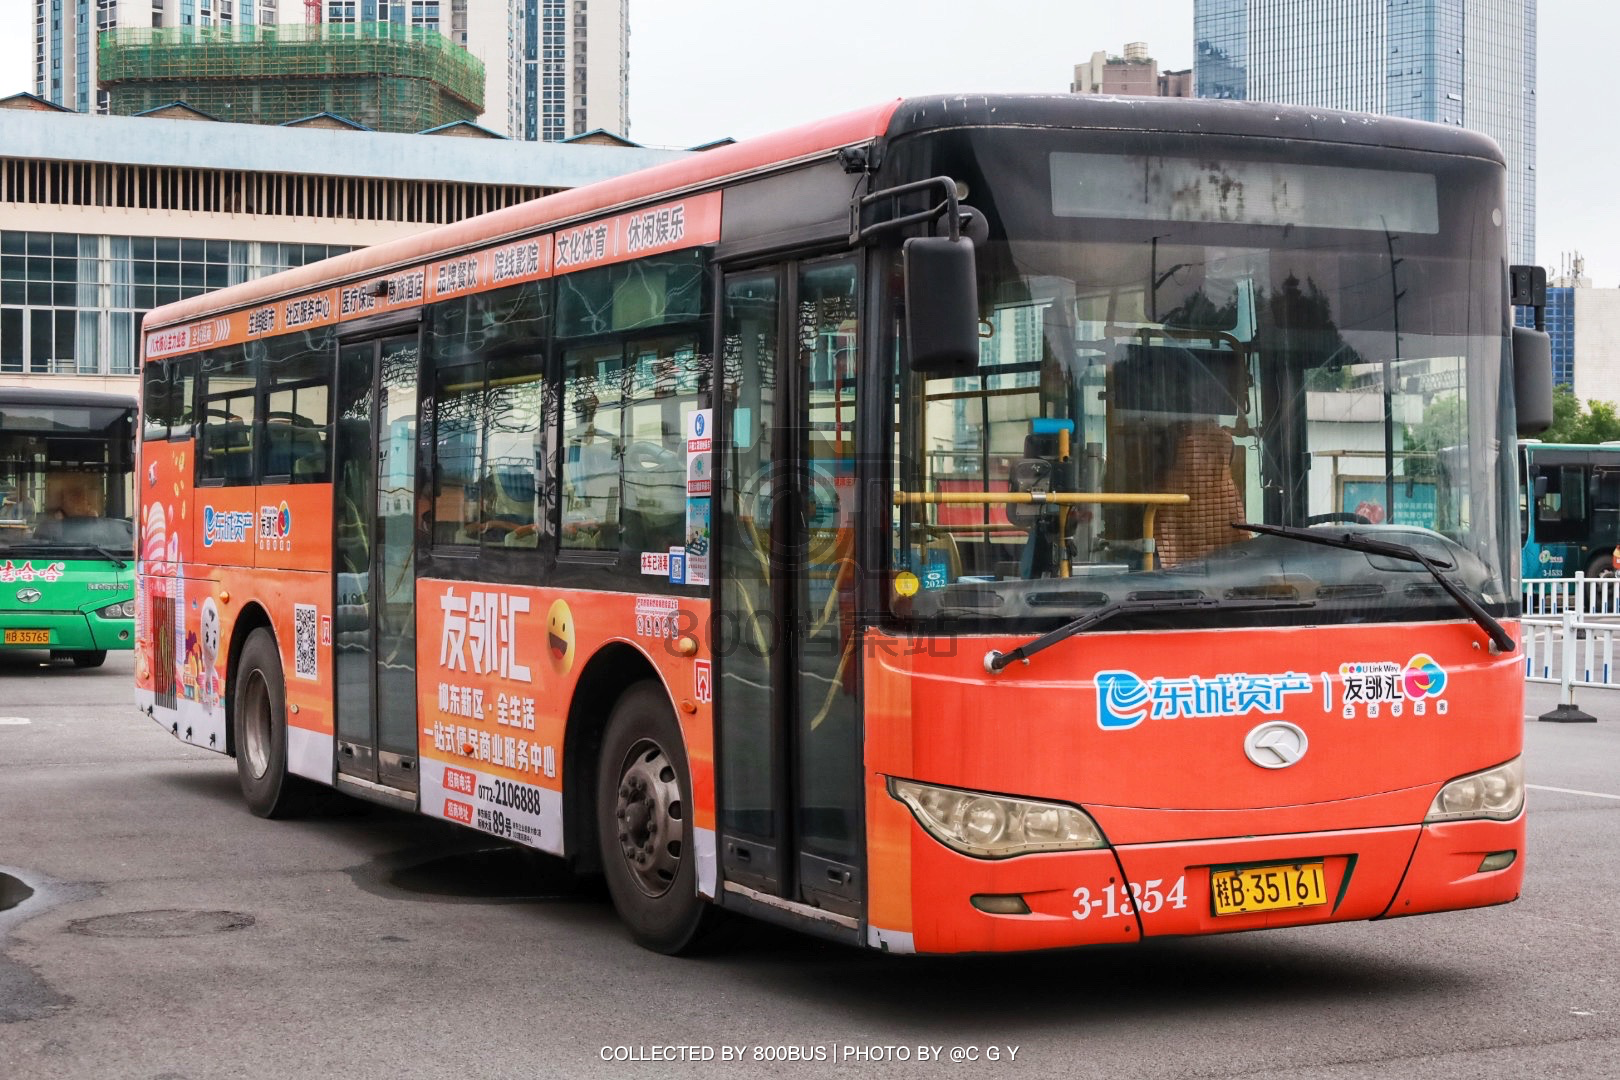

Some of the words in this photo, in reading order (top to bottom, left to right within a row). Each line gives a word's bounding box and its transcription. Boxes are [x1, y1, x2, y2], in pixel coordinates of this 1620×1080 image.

[286, 299, 330, 326] 社区服务中心
[437, 258, 477, 295] 品牌餐饮
[494, 241, 539, 282] 院线影院
[556, 226, 607, 266] 文化体育
[628, 204, 684, 251] 休闲娱乐
[440, 586, 532, 682] 友邻汇
[1345, 675, 1402, 700] 友邻汇
[1369, 664, 1383, 672] Link
[1151, 673, 1310, 718] 东城资产
[424, 720, 556, 778] 一站式便民商业服务中心
[447, 770, 472, 792] 招商电话
[479, 780, 541, 815] 0772-2106888
[1072, 876, 1187, 920] 3-1354
